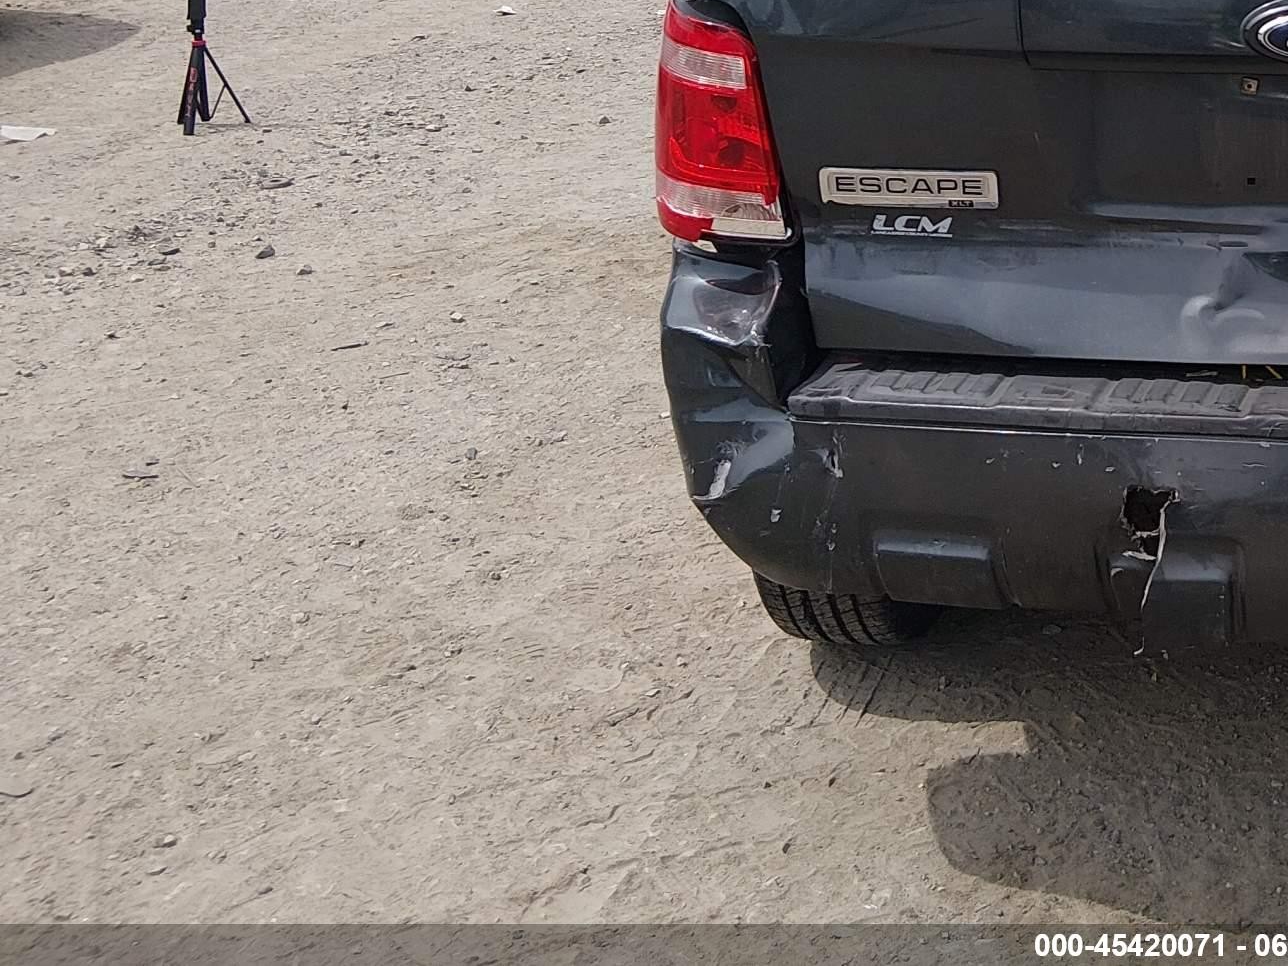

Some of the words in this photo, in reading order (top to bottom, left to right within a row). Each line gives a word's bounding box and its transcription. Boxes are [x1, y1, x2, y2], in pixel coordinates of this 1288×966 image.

[835, 176, 984, 196] ESCAPE
[951, 200, 972, 208] XLT
[872, 214, 953, 233] LCM
